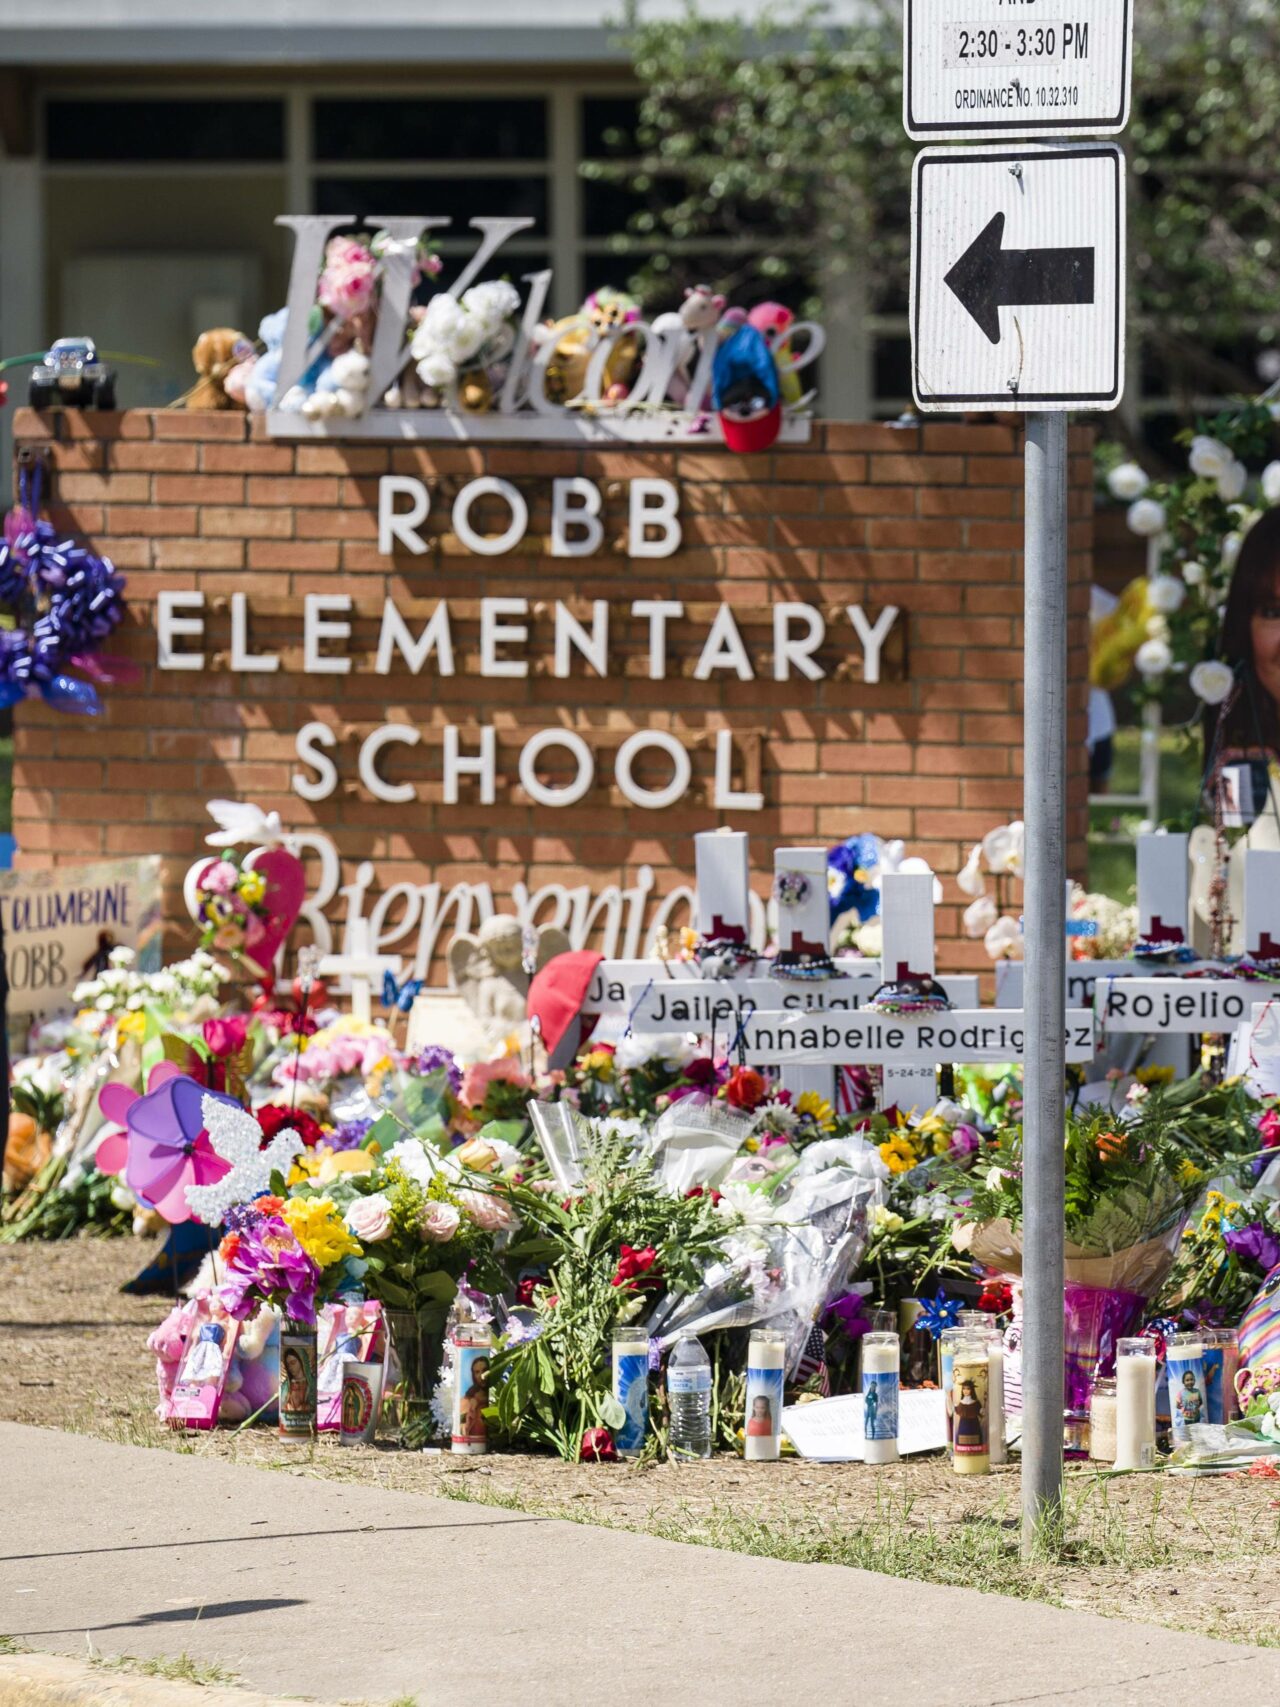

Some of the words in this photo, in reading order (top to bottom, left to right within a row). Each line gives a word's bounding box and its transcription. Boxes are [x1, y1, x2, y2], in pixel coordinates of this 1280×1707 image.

[958, 30, 998, 58] 2:30
[1016, 28, 1055, 56] 3:30
[1062, 22, 1089, 60] PM
[954, 88, 1013, 109] ORDINANCE
[1035, 86, 1079, 107] 10.32.310
[378, 475, 683, 558] ROBB
[156, 591, 900, 683] ELEMENTARY
[292, 721, 765, 810] SCHOOL
[10, 940, 68, 991] OBB
[1107, 991, 1243, 1027] Rojelio
[887, 1068, 934, 1077] 5-24-22
